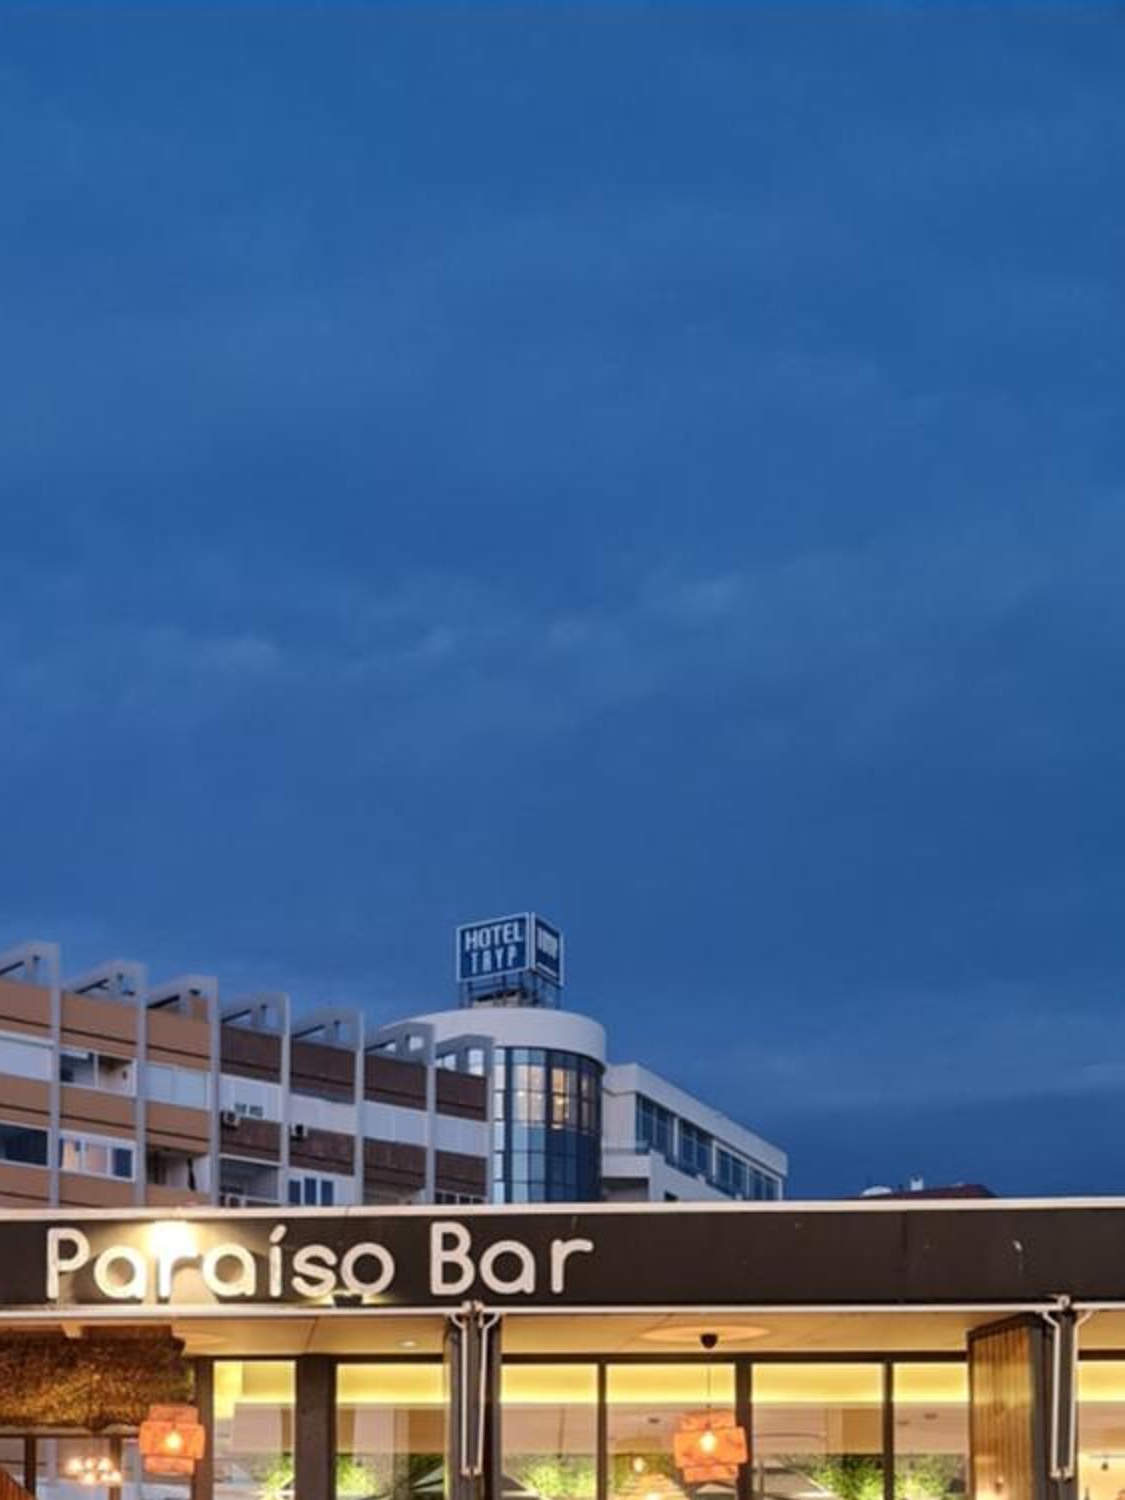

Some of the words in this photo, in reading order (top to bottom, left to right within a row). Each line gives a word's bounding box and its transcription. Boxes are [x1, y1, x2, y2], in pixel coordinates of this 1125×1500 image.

[464, 920, 523, 952] HOTEL
[470, 945, 518, 974] TRYP
[45, 1224, 396, 1299] Paraíso
[429, 1222, 594, 1295] Bar
